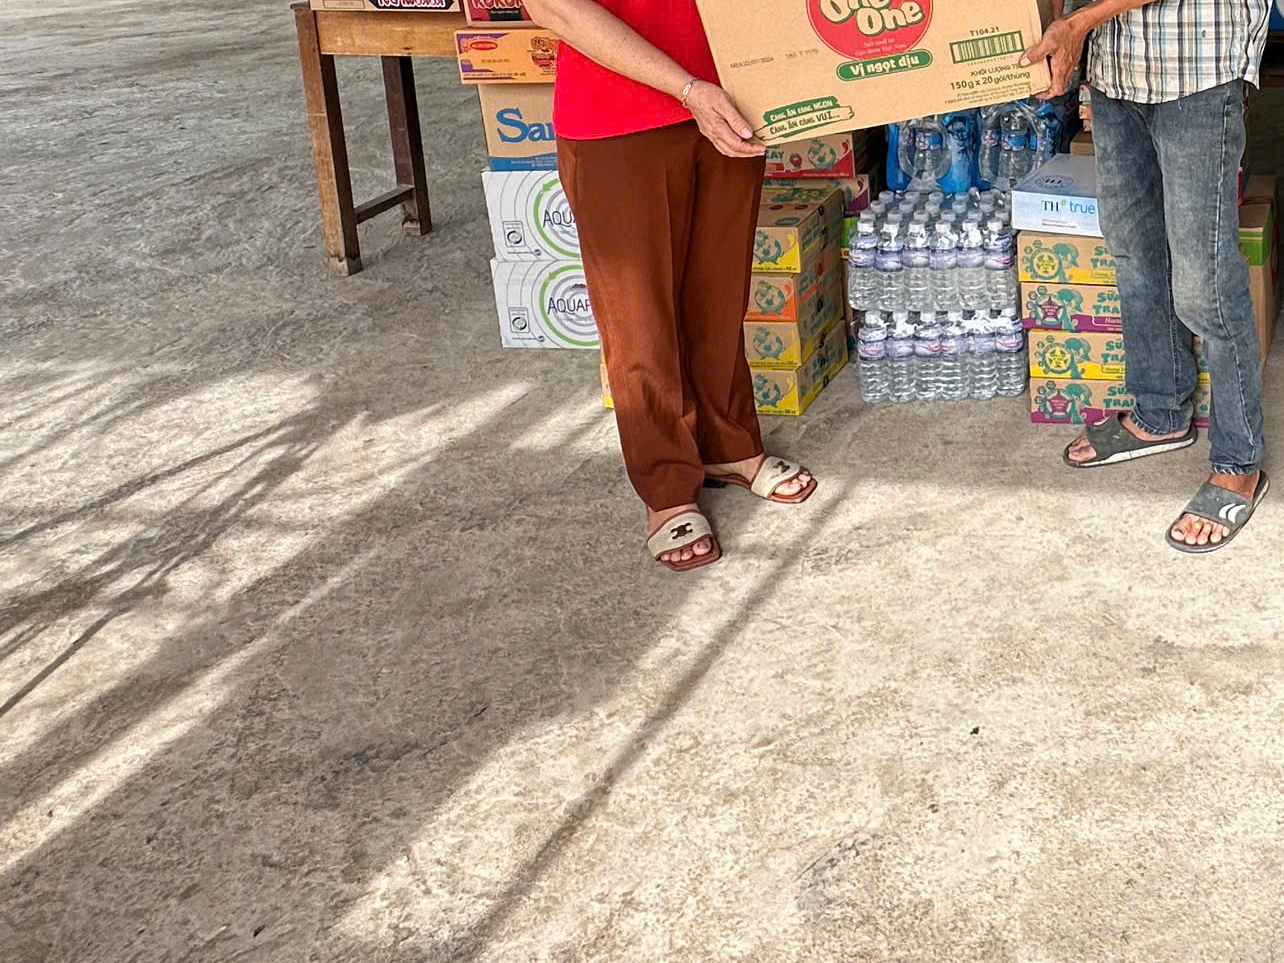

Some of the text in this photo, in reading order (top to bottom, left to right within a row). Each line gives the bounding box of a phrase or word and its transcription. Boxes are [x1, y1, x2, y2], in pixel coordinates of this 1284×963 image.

[856, 1, 924, 36] One
[850, 55, 920, 76] Vị ngọt dịu
[982, 75, 993, 85] 20
[1070, 201, 1096, 214] true
